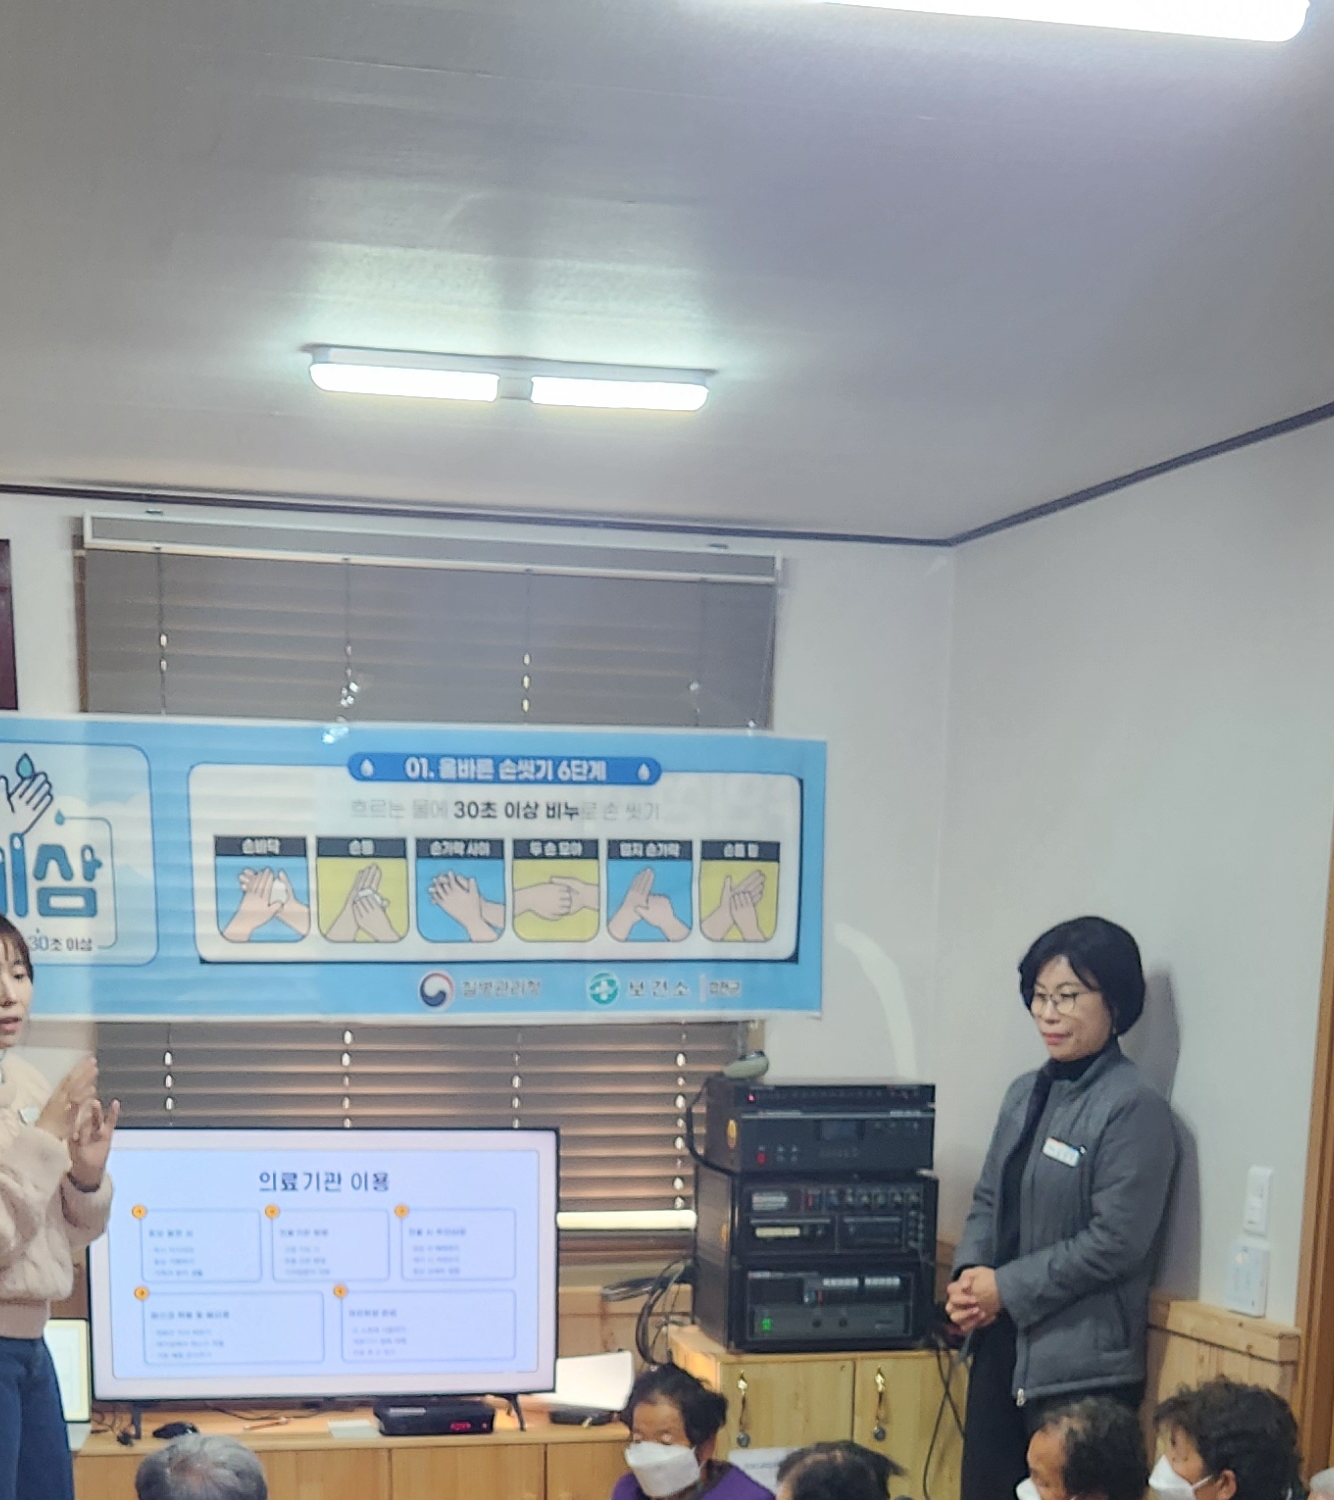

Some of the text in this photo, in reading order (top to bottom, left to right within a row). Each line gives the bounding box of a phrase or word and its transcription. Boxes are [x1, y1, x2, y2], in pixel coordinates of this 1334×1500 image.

[405, 756, 607, 781] 01. 올바른 손씻기 6단계
[454, 800, 497, 819] 30초
[504, 801, 539, 820] 이상
[259, 1171, 389, 1192] 의료기관 이용
